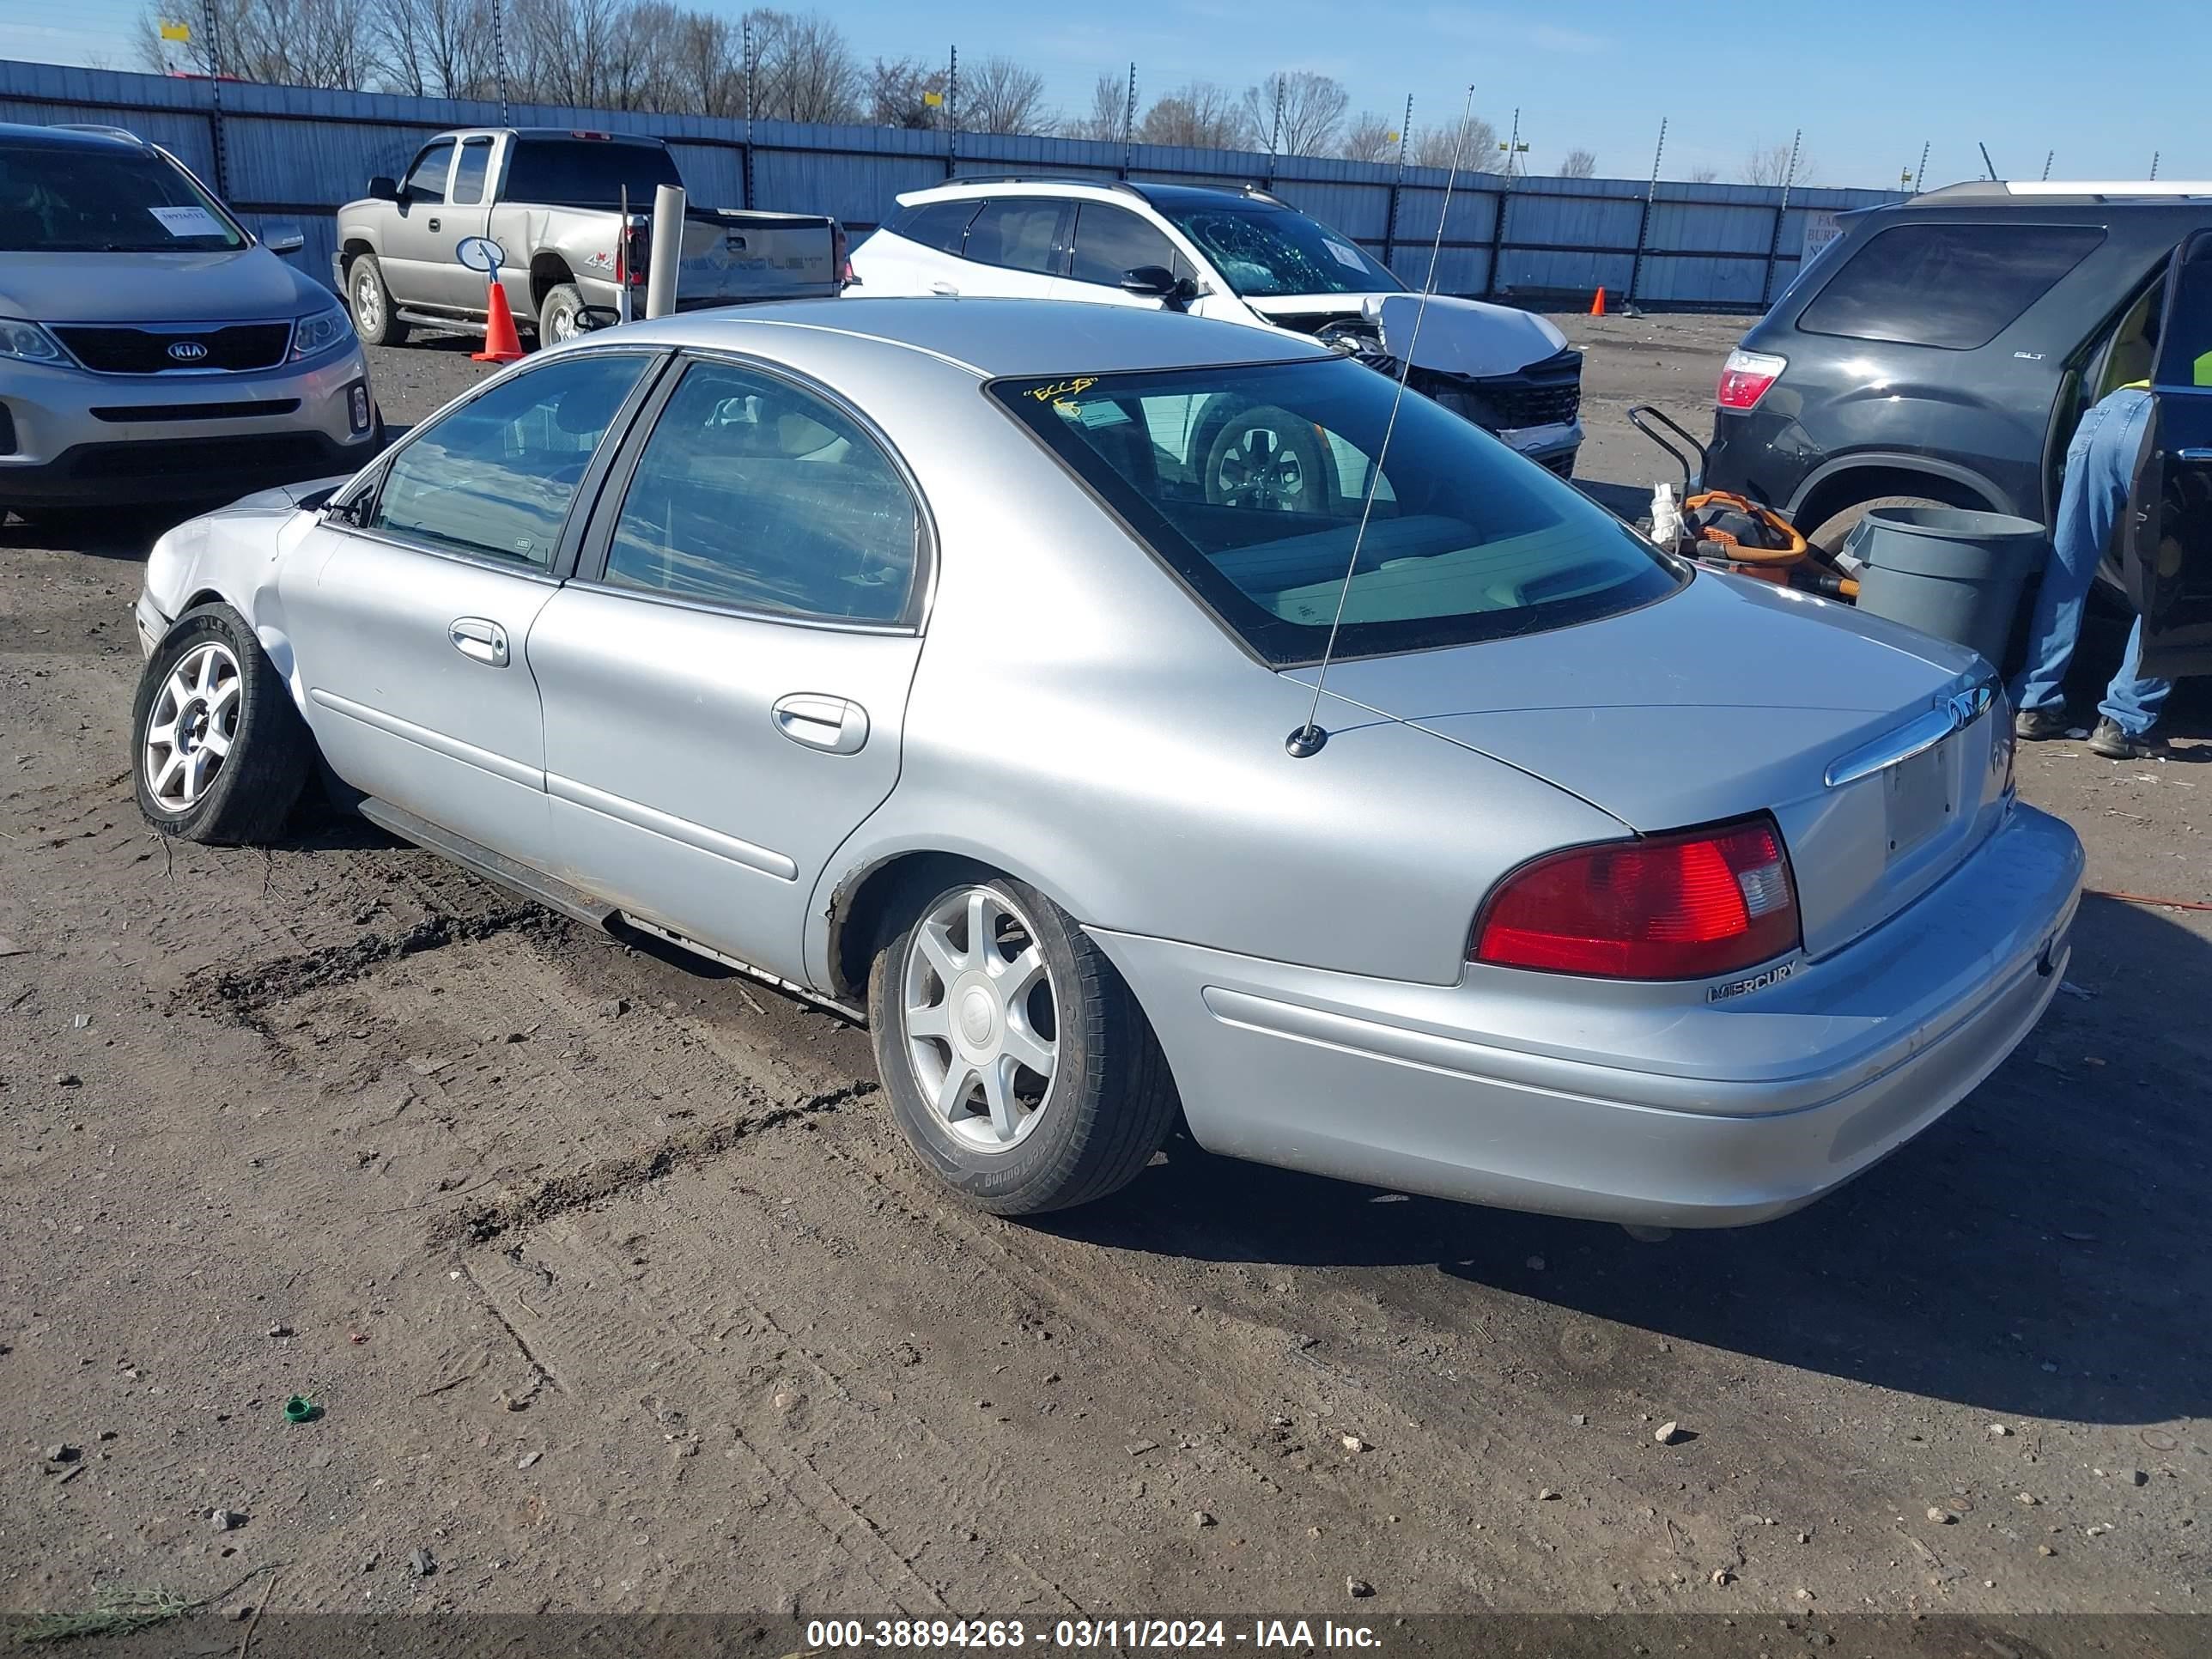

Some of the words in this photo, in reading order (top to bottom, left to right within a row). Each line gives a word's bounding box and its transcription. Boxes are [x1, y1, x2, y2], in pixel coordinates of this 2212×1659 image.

[174, 345, 203, 357] KIA
[2013, 351, 2047, 360] SLT
[1706, 960, 1797, 1004] MERCURY
